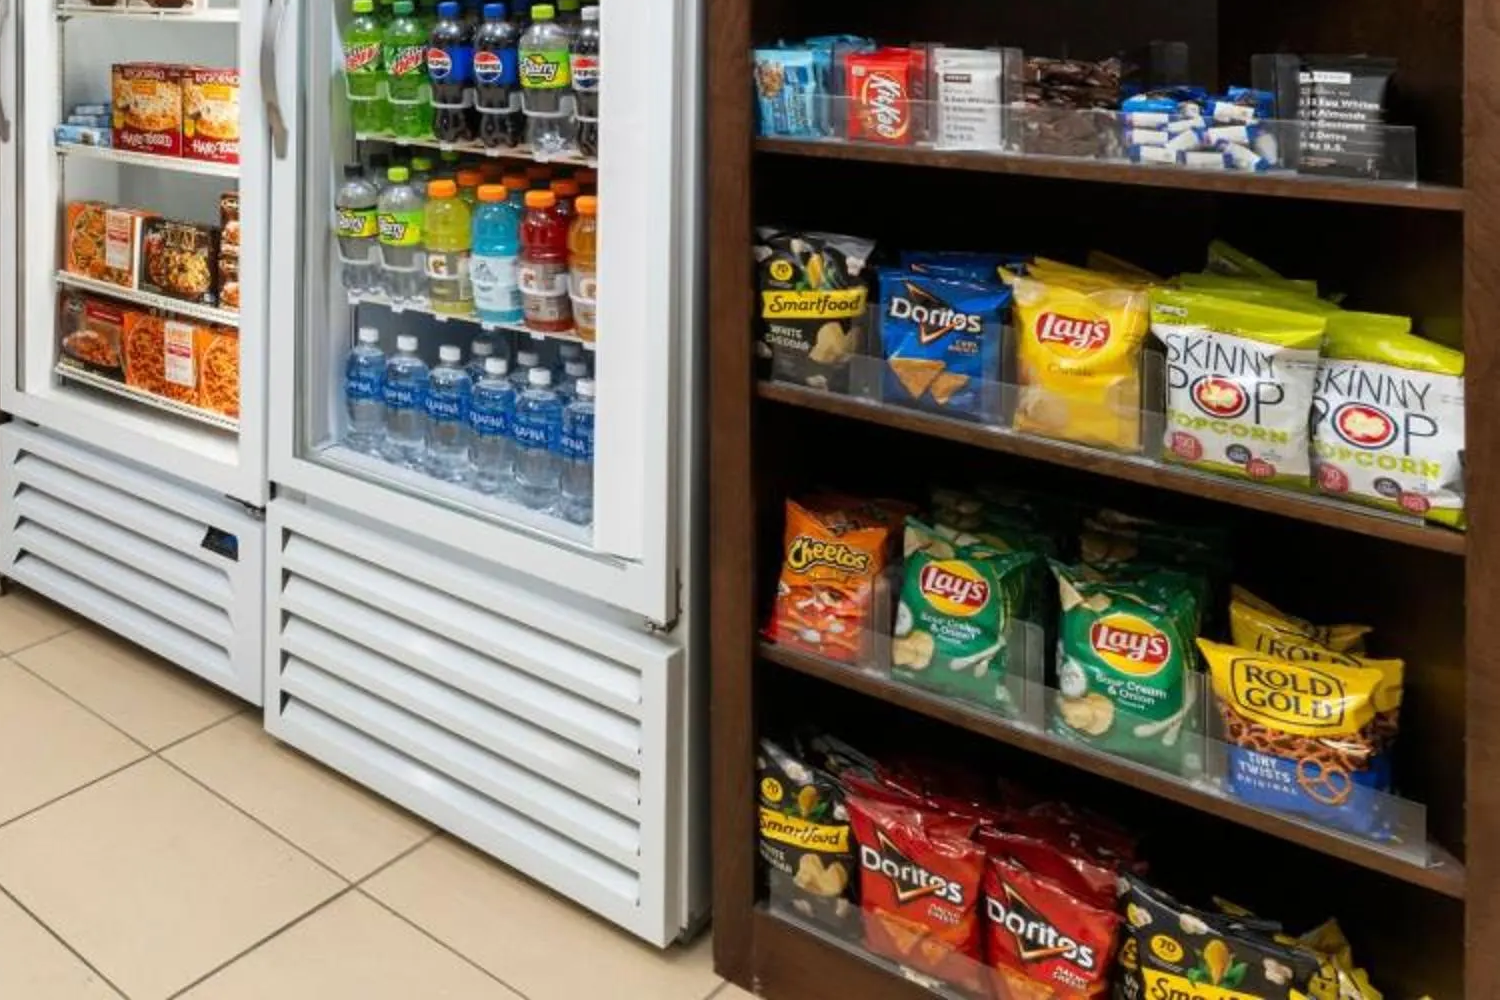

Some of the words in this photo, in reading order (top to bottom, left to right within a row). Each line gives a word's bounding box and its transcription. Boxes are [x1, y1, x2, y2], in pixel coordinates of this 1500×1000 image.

[769, 294, 860, 314] Smartfood
[889, 296, 982, 334] Doritos
[770, 324, 803, 340] WHITE
[1038, 312, 1109, 349] Lay's
[1166, 332, 1276, 380] SKINNY
[1167, 365, 1285, 425] POP
[1310, 395, 1438, 456] POP
[787, 535, 871, 572] Cheetos
[924, 566, 984, 606] Lay's
[1096, 624, 1167, 661] Lay's
[1095, 672, 1124, 690] Sour
[1126, 680, 1168, 700] Cream
[1107, 684, 1118, 697] &
[1118, 686, 1155, 706] Onion
[1245, 664, 1333, 697] ROLD
[1245, 687, 1333, 719] GOLD
[1238, 760, 1291, 783] TWISTS
[1248, 754, 1278, 767] TINY
[860, 845, 964, 905] Doritos
[987, 896, 1095, 970] Doritos
